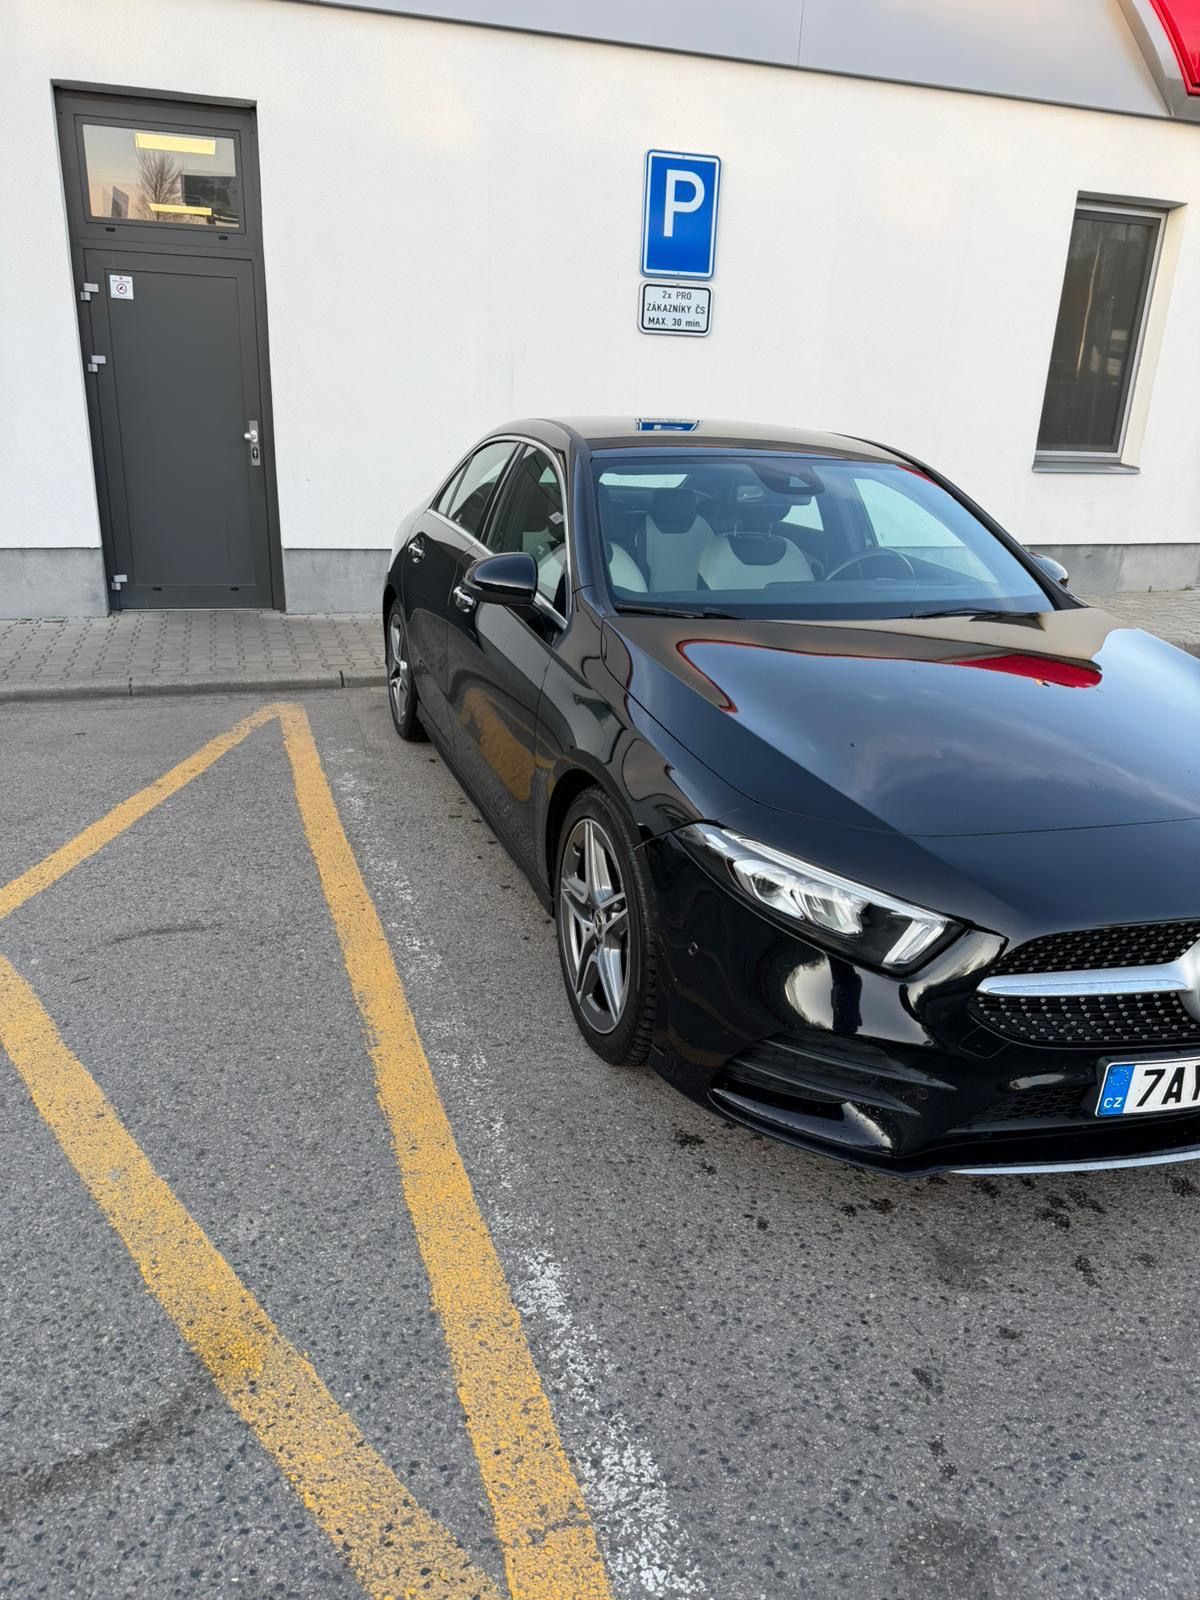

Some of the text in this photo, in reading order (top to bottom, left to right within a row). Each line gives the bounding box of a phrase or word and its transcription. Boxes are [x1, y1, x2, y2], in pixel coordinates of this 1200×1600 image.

[663, 168, 705, 237] P
[662, 290, 692, 301] 2x PRO
[646, 301, 706, 315] ZÁKAZNÍKY ČS
[648, 316, 702, 328] MAX. 30 min.
[1103, 1096, 1123, 1109] CZ
